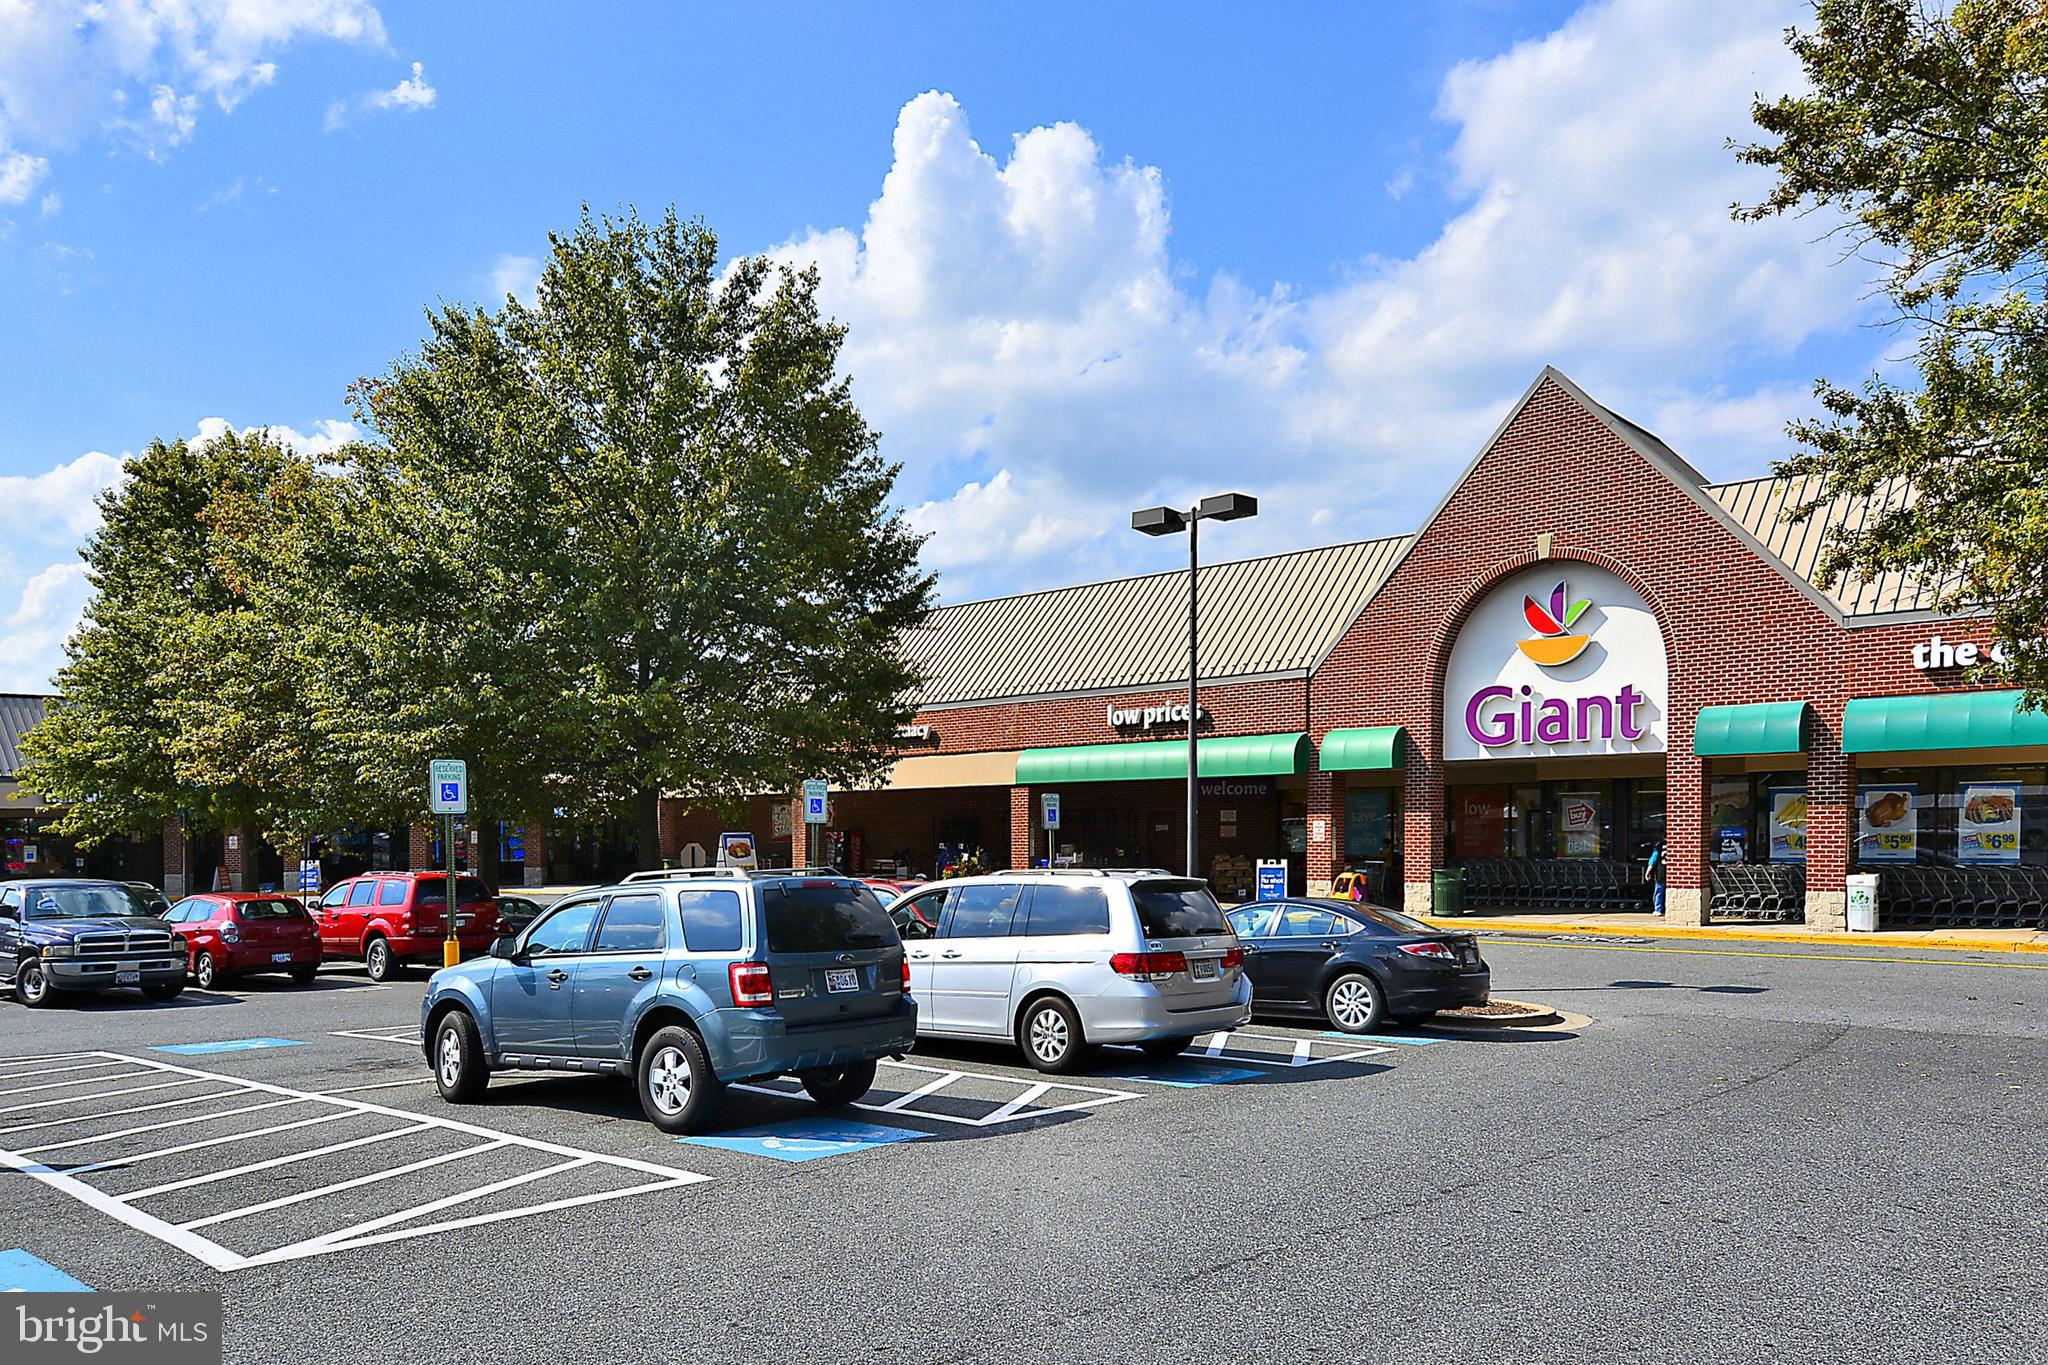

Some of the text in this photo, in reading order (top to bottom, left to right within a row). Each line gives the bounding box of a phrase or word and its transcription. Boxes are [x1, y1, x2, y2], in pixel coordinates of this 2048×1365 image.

[1911, 635, 1977, 669] the
[1107, 703, 1140, 726] low
[1465, 684, 1643, 746] Giant
[433, 765, 464, 773] RESERVED
[437, 773, 462, 781] PARKING
[1201, 781, 1267, 795] welcome
[1464, 800, 1490, 815] low
[1570, 811, 1587, 820] buy
